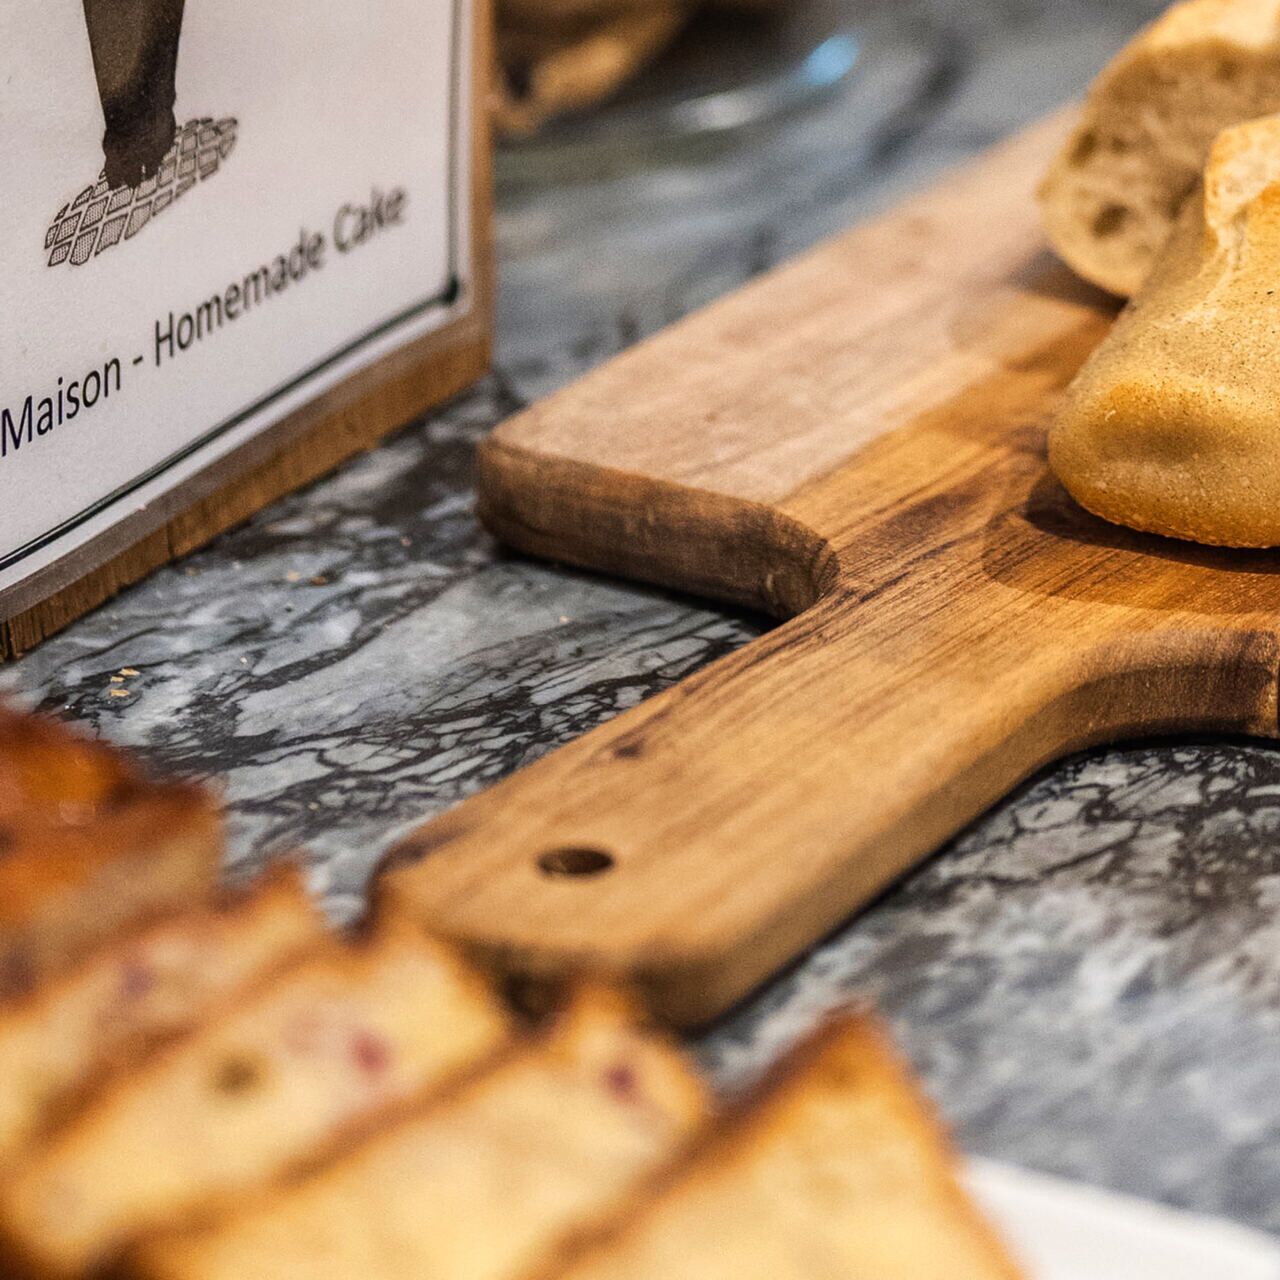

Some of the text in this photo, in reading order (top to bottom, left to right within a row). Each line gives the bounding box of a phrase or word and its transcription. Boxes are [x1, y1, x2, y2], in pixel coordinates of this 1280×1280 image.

[2, 186, 408, 457] Maison - Homemade Cake
